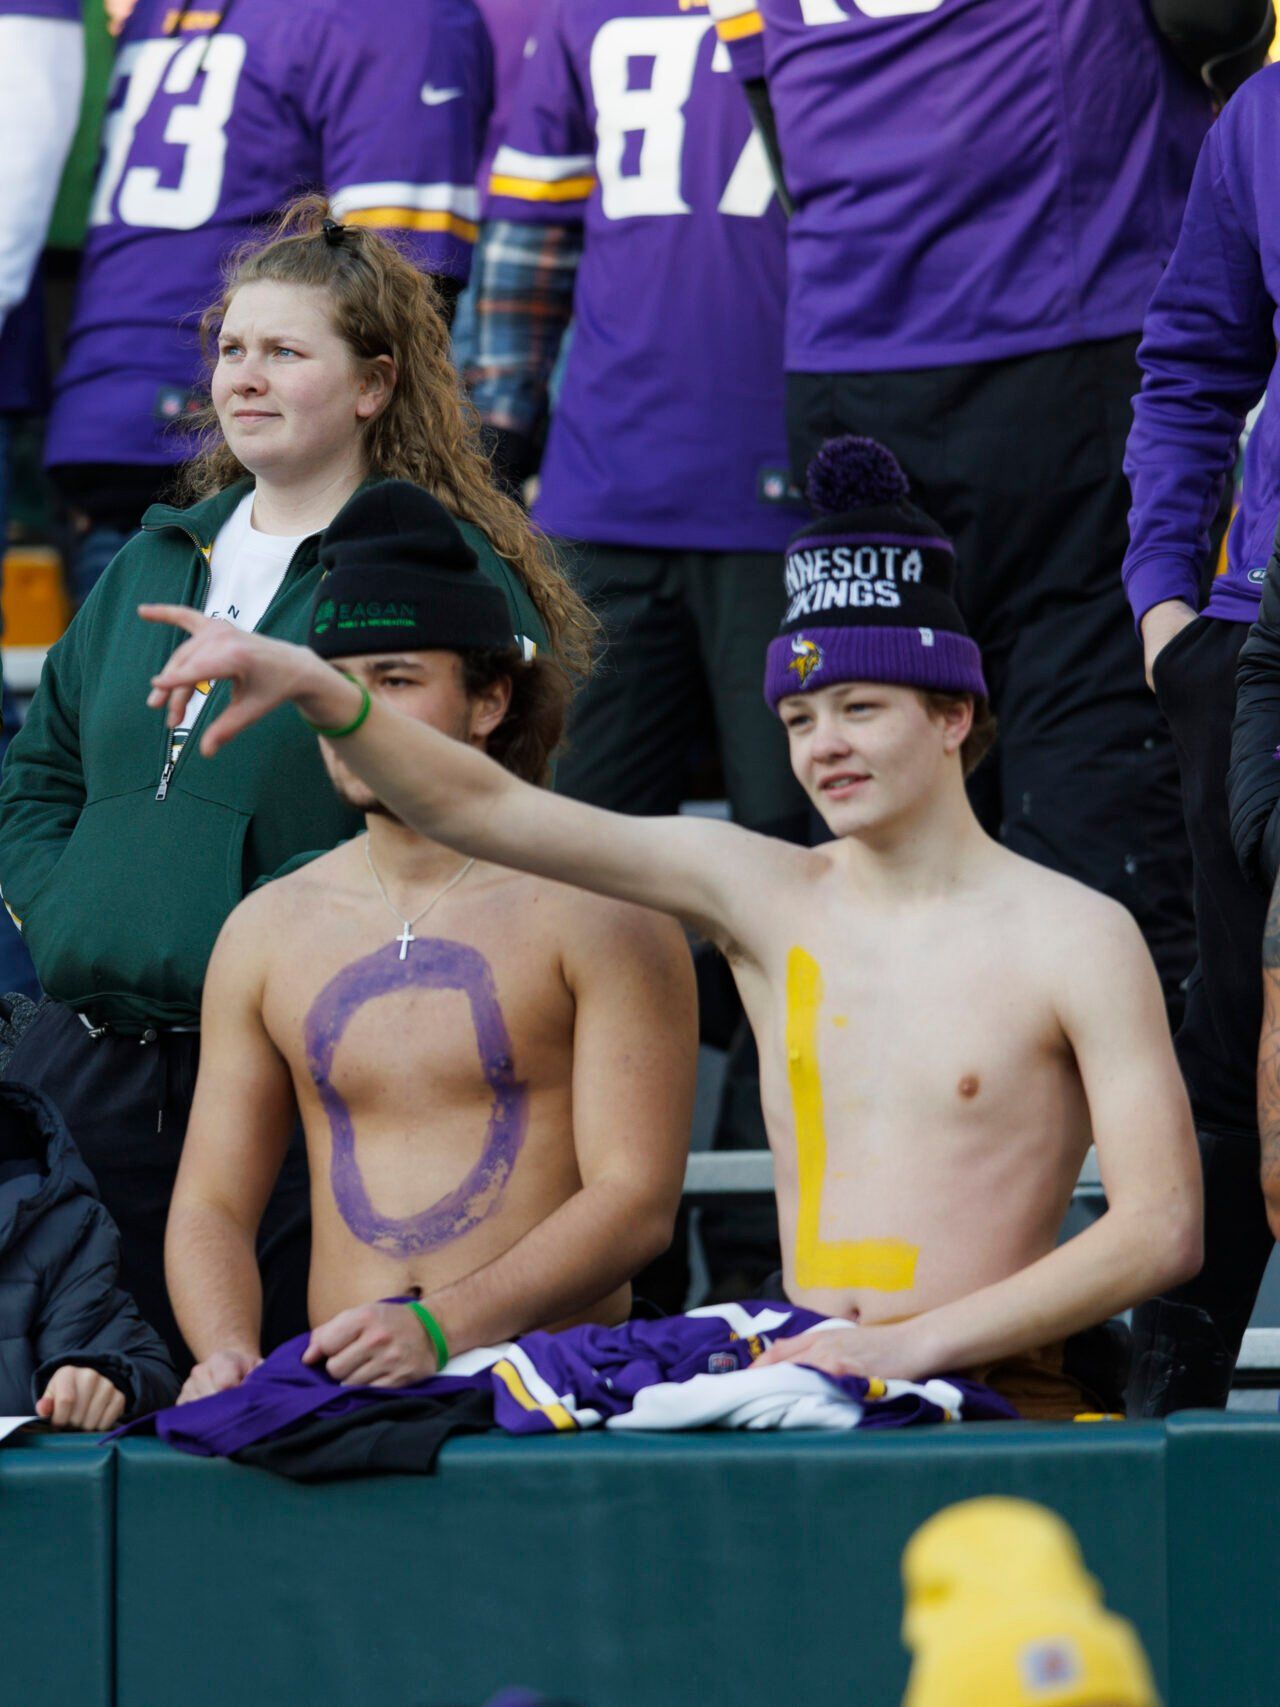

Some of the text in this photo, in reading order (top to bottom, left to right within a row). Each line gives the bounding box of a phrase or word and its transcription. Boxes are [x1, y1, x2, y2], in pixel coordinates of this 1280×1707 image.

[786, 546, 923, 597] NNESOTA
[339, 601, 417, 619] EAGAN
[786, 944, 919, 1292] L
